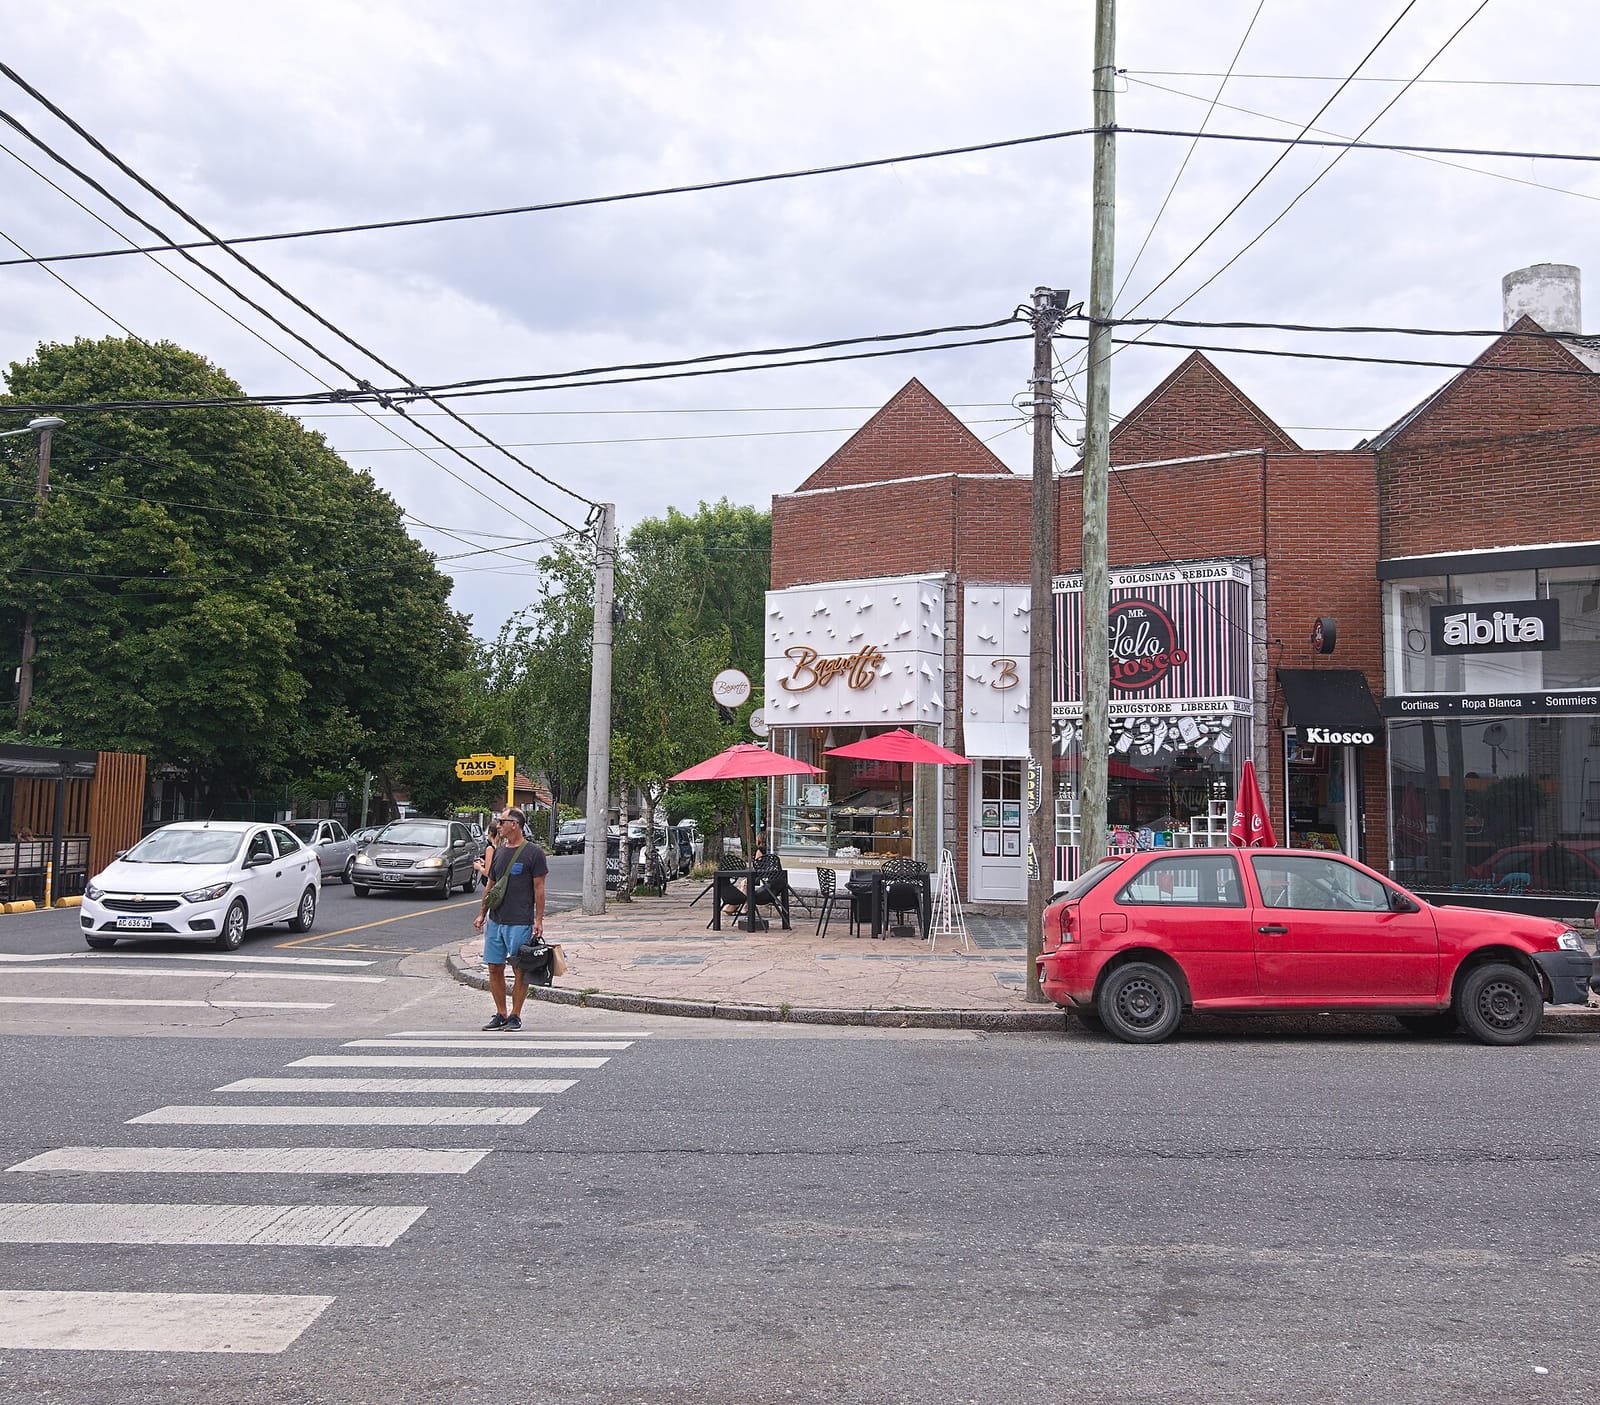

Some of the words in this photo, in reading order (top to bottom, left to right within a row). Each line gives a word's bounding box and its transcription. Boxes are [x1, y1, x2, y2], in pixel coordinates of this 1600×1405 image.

[1052, 576, 1114, 589] CIGARRS
[1119, 571, 1176, 584] GOLOSINAS
[1182, 567, 1228, 580] BEBIDAS
[1128, 609, 1147, 618] MR.
[781, 645, 886, 691] Baguette
[1109, 649, 1188, 680] iosco
[990, 658, 1020, 690] B
[1401, 700, 1440, 711] Cortinas
[1461, 699, 1486, 710] Ropa
[1488, 697, 1522, 708] Blanca
[1545, 695, 1598, 706] Sommiers
[1053, 706, 1083, 715] REGAL
[1110, 703, 1172, 714] DRUGSTORE
[1181, 702, 1229, 712] LIBRERIA
[1306, 728, 1375, 744] Kiosco
[459, 760, 497, 770] TAXIS
